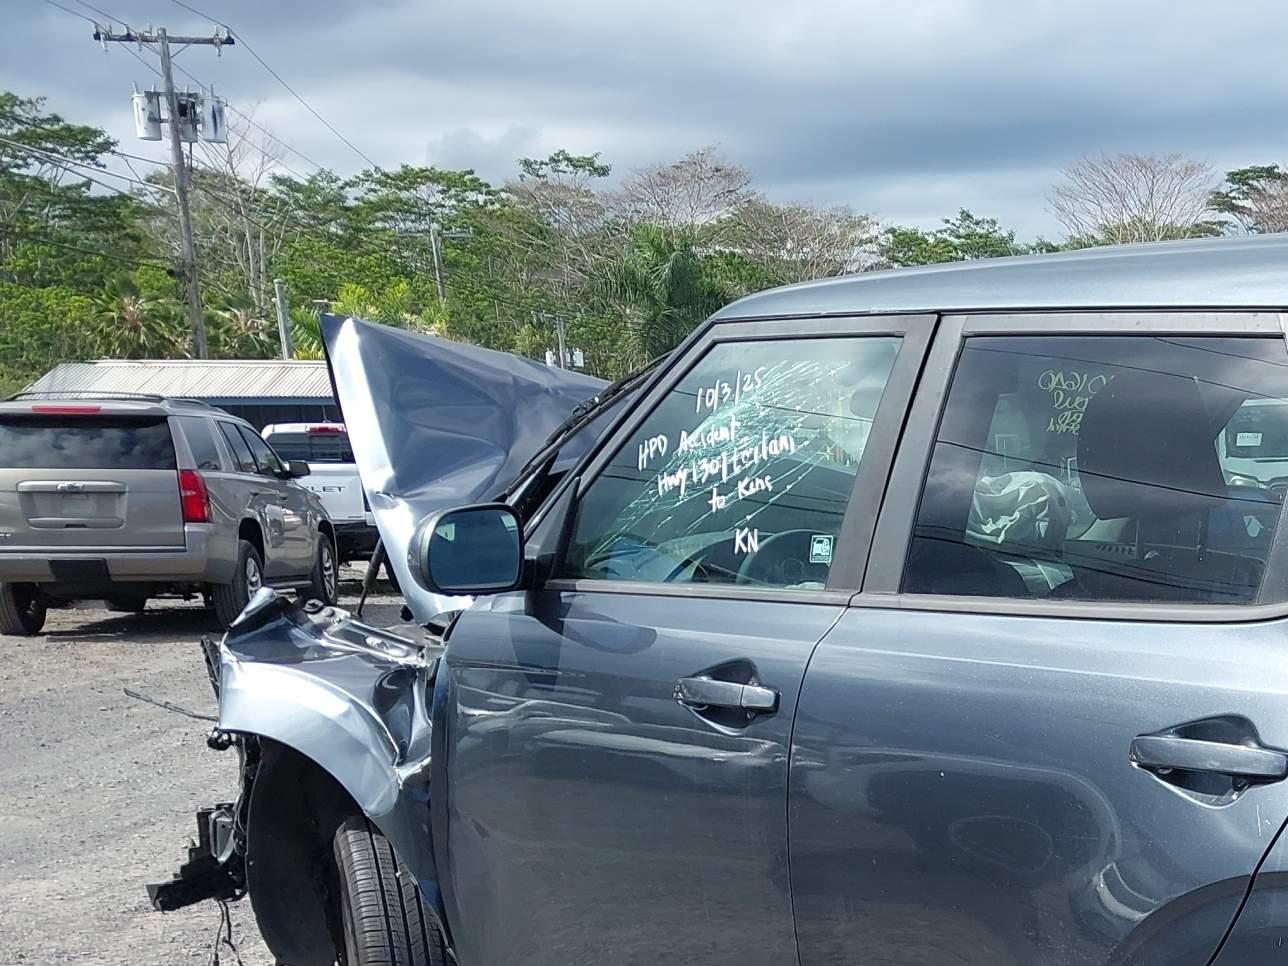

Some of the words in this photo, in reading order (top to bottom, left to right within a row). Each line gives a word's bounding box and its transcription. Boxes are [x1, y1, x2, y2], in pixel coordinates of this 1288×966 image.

[696, 366, 767, 414] 10/3/25
[637, 434, 668, 471] HPD
[734, 527, 759, 555] KN
